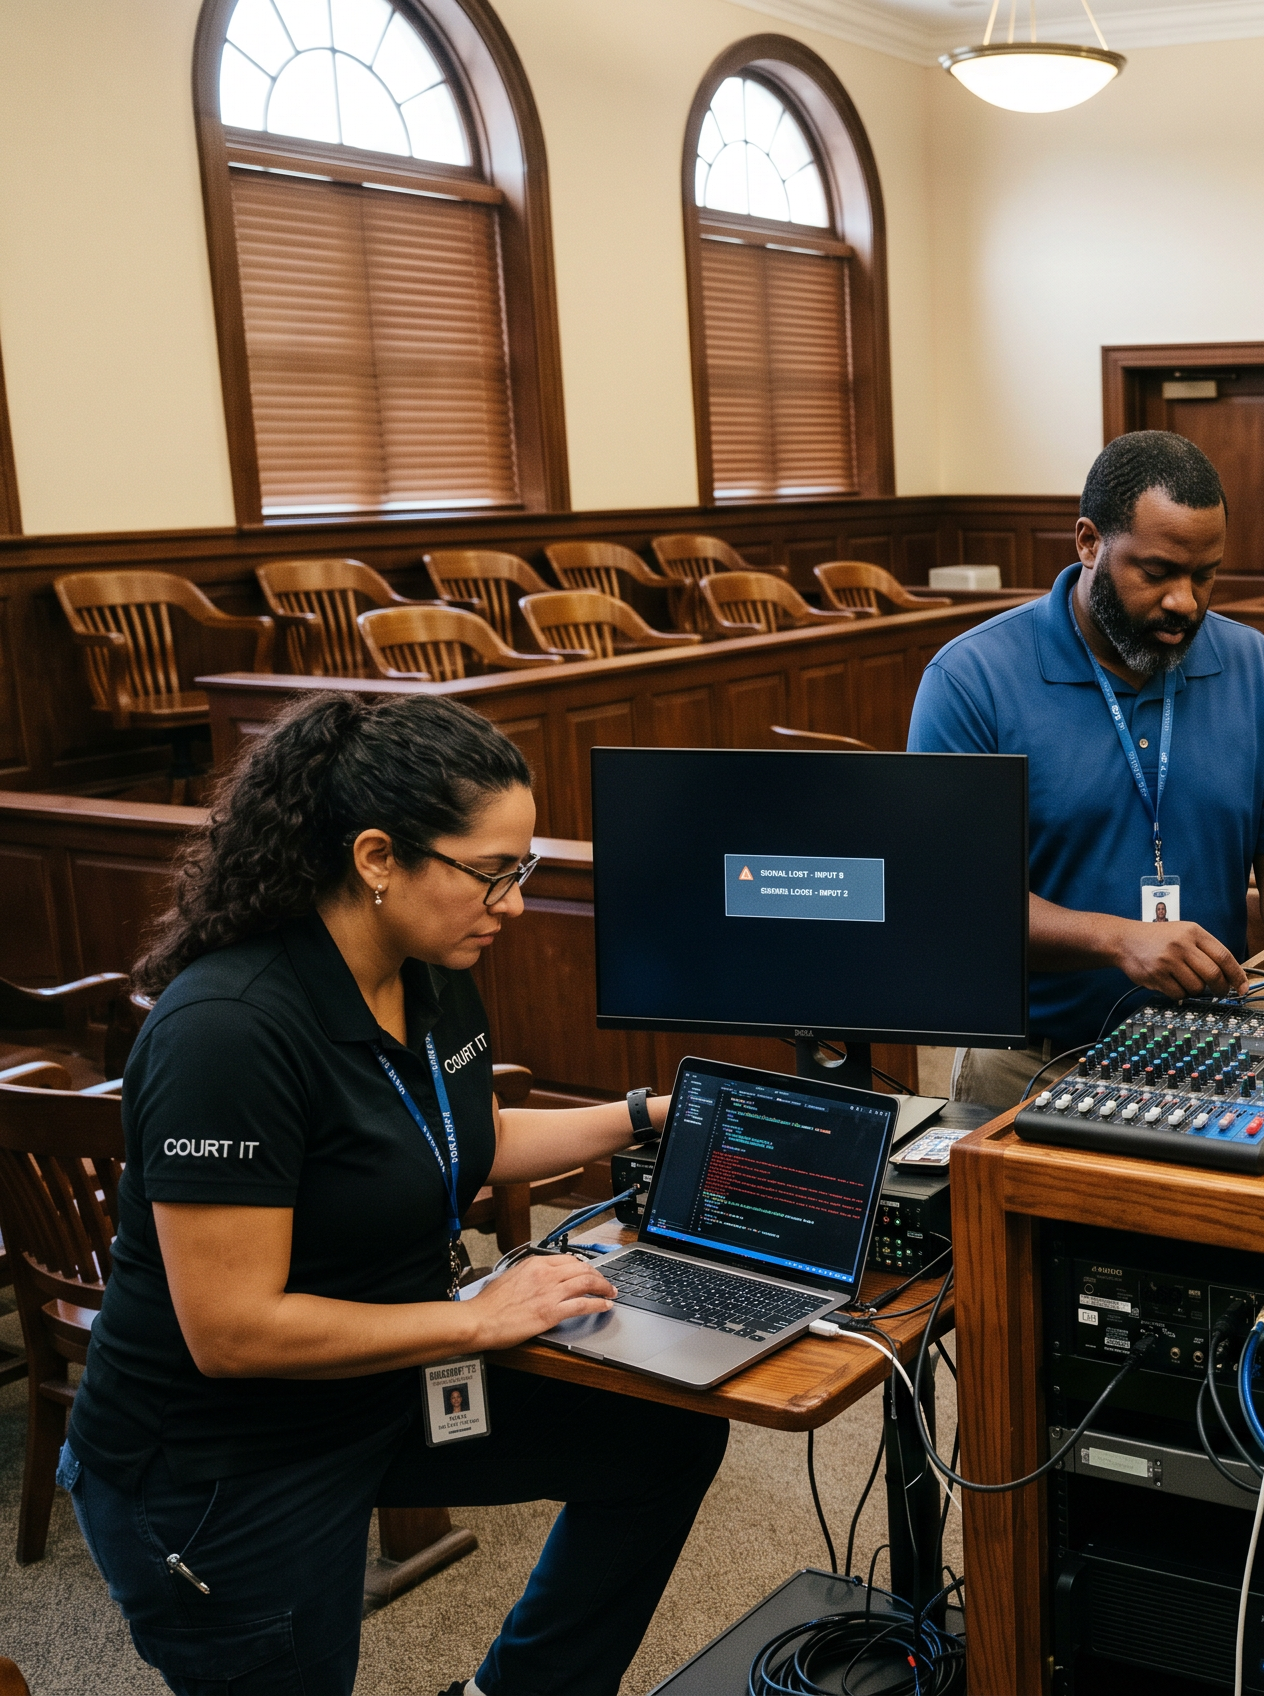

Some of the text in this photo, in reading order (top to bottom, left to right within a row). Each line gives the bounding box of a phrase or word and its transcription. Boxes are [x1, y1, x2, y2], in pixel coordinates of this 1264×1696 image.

[788, 870, 808, 878] LOST
[815, 871, 837, 879] INPUT
[444, 1041, 478, 1074] COURT
[474, 1032, 488, 1052] IT
[163, 1138, 260, 1159] COURT IT
